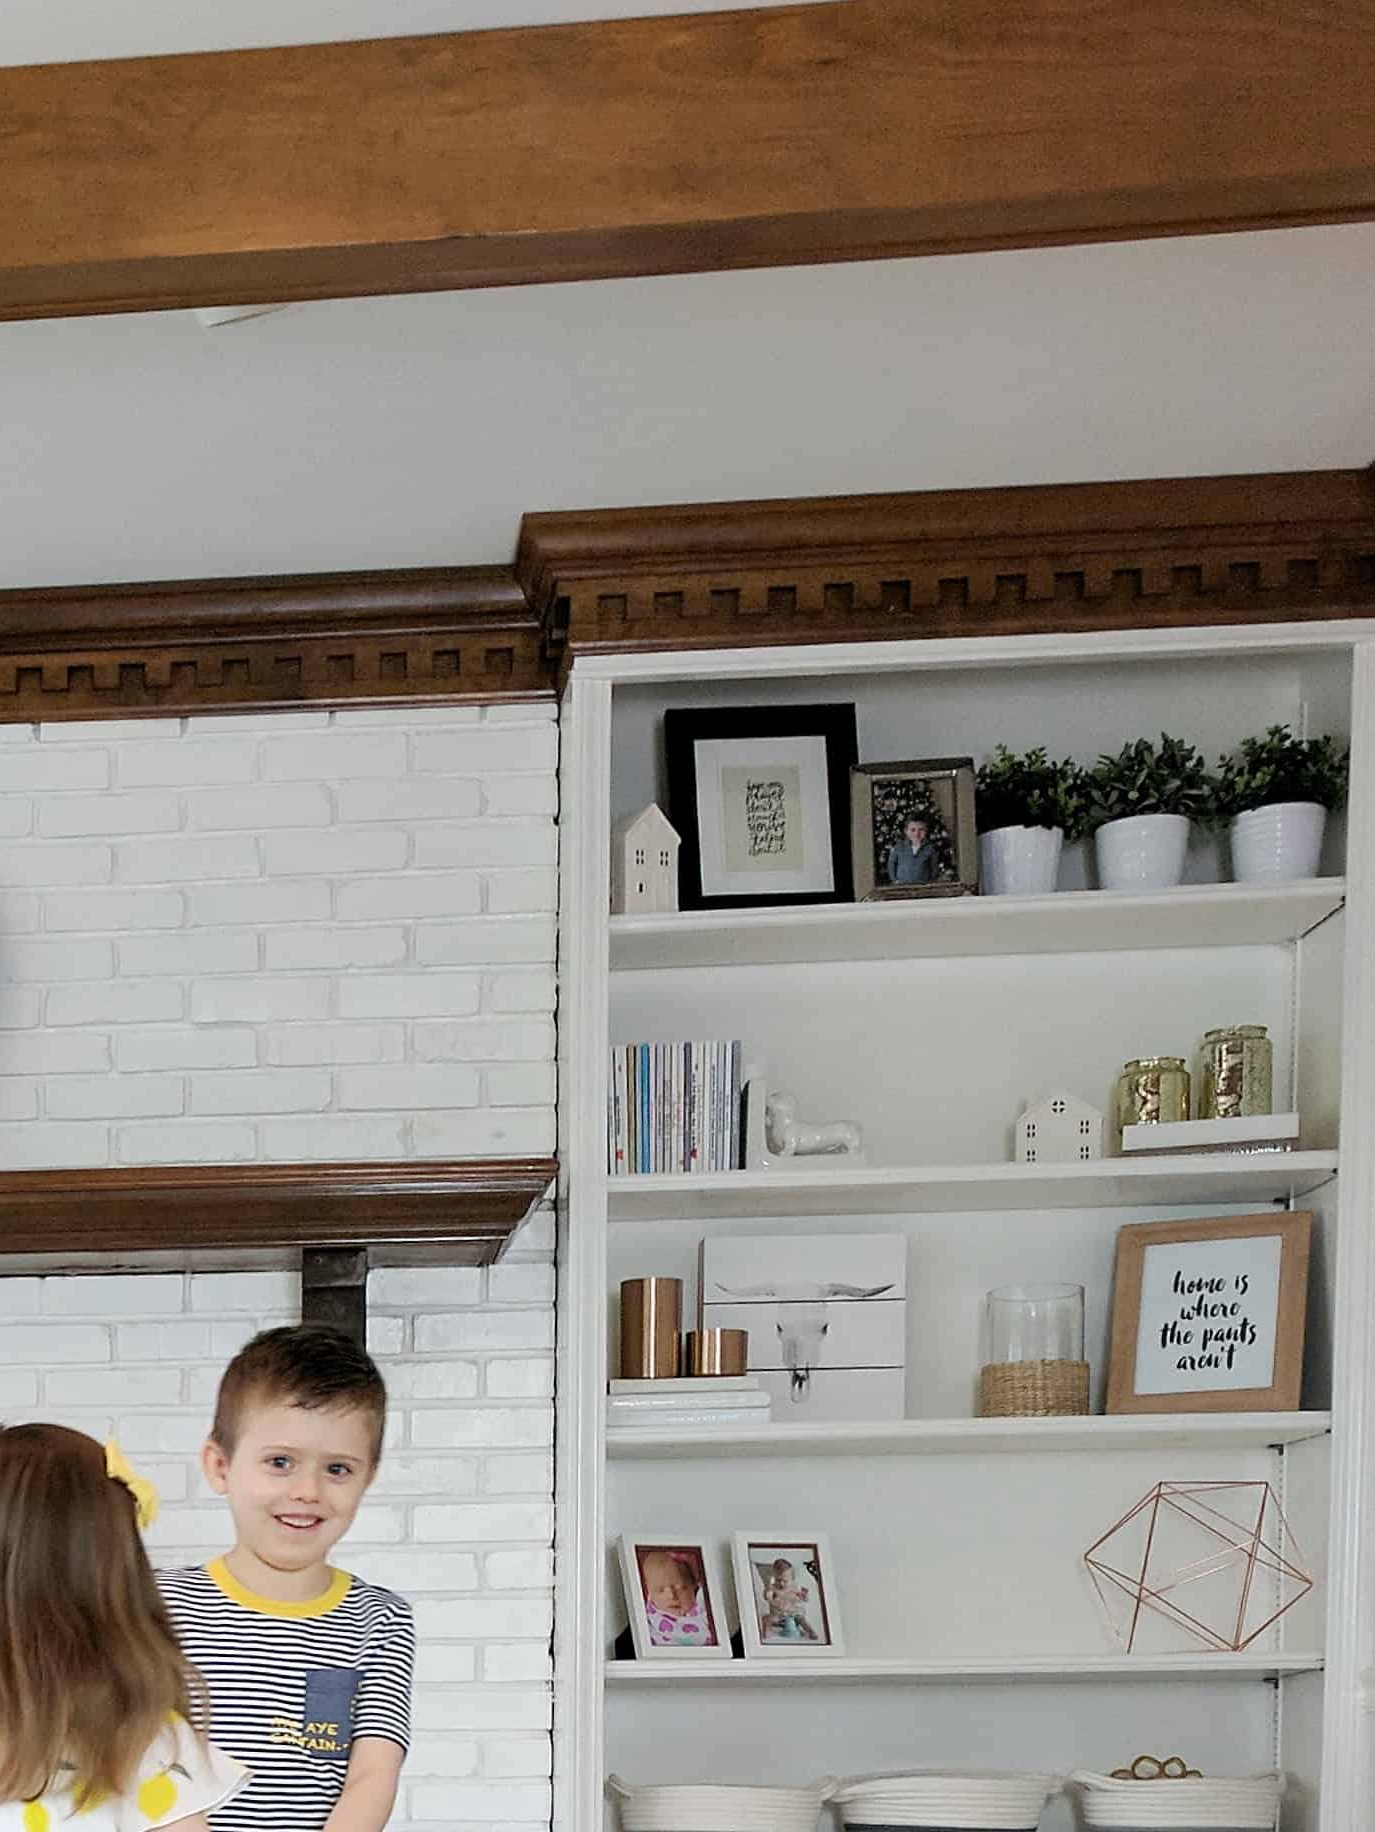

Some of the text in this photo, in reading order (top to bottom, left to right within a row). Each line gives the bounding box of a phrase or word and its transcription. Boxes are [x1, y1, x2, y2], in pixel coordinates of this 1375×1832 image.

[1173, 1270, 1249, 1295] home is
[1180, 1293, 1242, 1320] where
[1160, 1317, 1256, 1352] the pants
[1176, 1344, 1236, 1371] aren't
[306, 1721, 338, 1736] AYE
